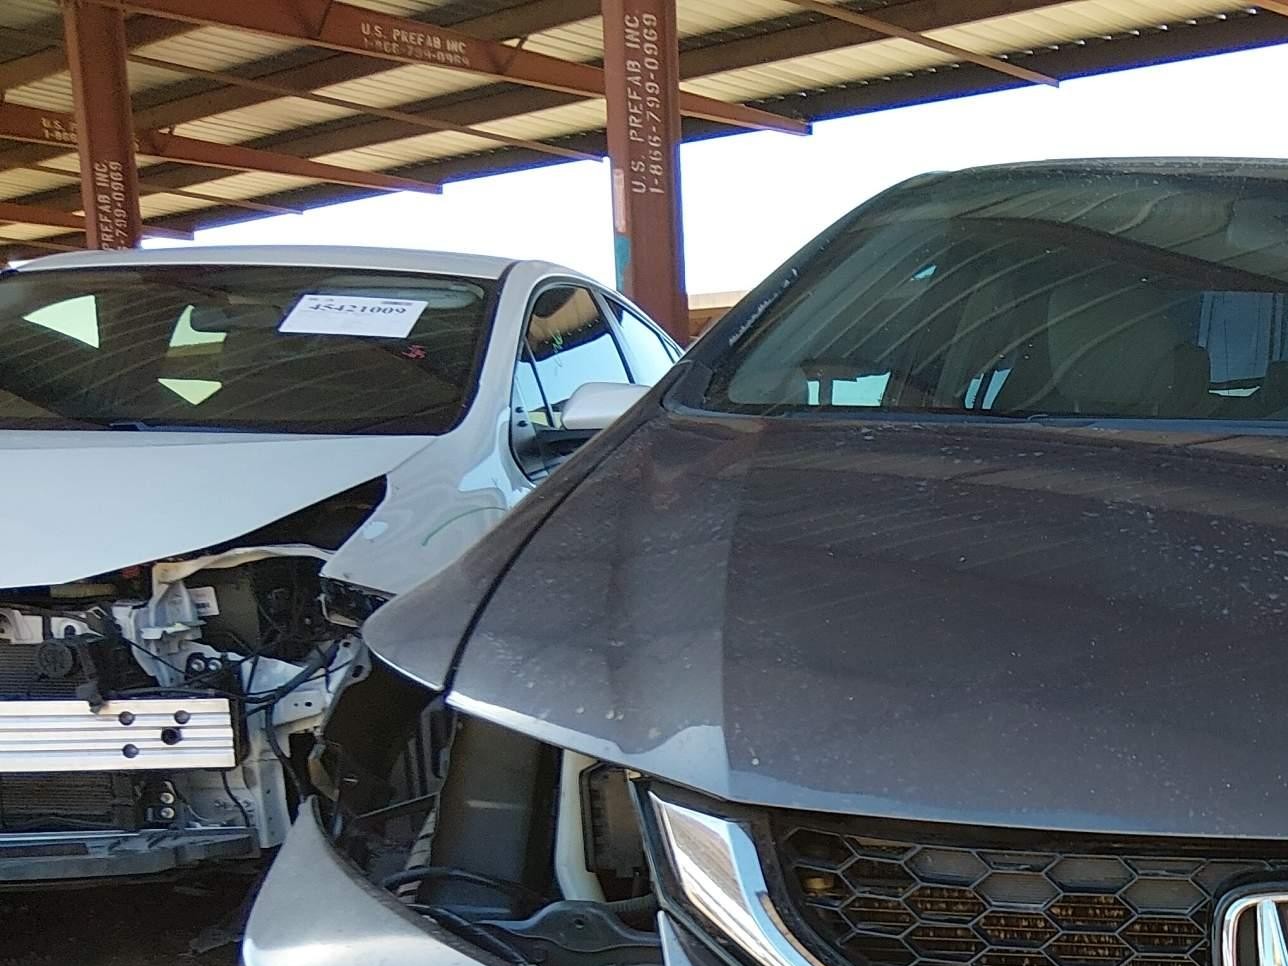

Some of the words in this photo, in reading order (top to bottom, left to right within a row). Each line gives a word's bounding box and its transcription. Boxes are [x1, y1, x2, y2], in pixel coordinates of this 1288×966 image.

[393, 28, 441, 49] PREFAB
[626, 60, 644, 142] PREFAB
[643, 14, 664, 193] 1-866-799-0969
